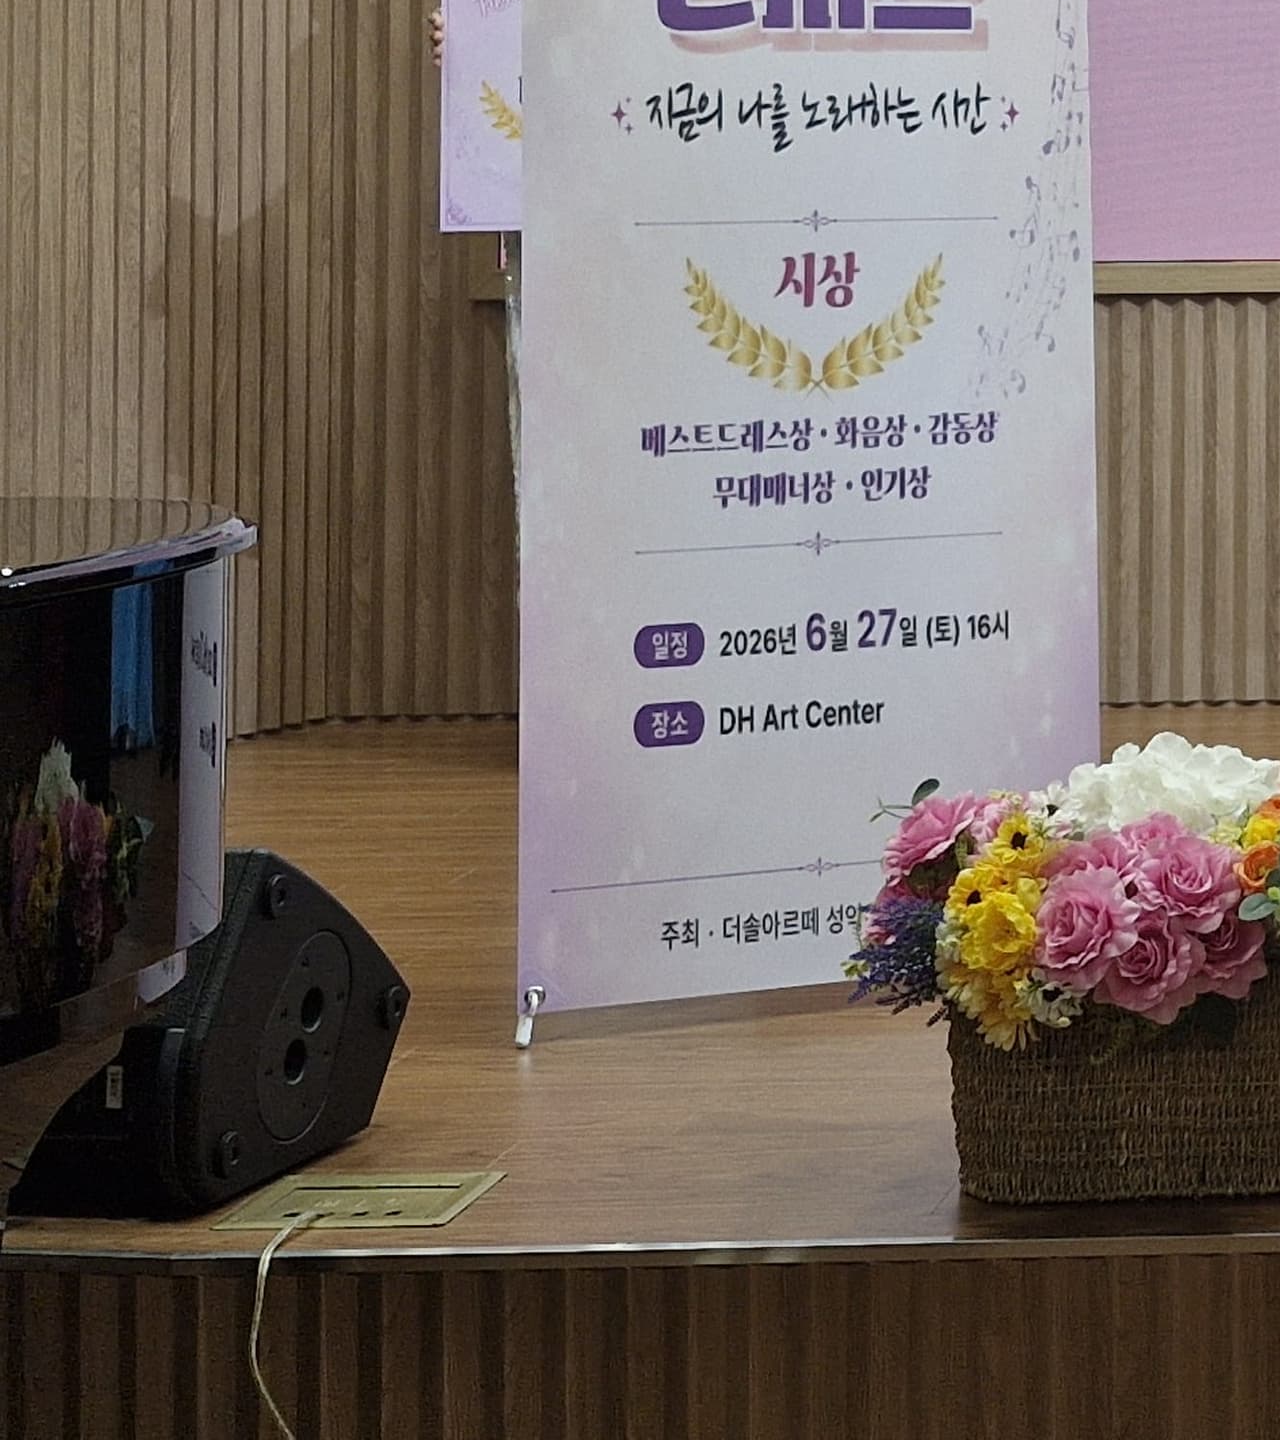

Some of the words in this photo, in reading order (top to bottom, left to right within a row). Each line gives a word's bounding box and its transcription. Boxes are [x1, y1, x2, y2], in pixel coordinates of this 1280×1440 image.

[646, 81, 724, 144] 지금의
[738, 82, 794, 153] 나를
[801, 80, 923, 135] 노래하는
[931, 80, 992, 136] 시간
[774, 251, 861, 309] 시상
[834, 414, 908, 450] 화음상
[928, 410, 1001, 446] 감동상
[712, 470, 837, 510] 무대매너상
[861, 465, 934, 502] 인기상
[650, 630, 689, 661] 일정
[719, 623, 797, 658] 2026년
[805, 612, 849, 653] 6월
[857, 607, 918, 649] 27일
[925, 615, 961, 649] (토)
[966, 609, 1010, 642] 16시
[650, 709, 689, 740] 장소
[719, 705, 755, 736] DH
[762, 702, 799, 733] Art
[804, 698, 885, 730] Center
[660, 917, 700, 952] 주최
[722, 906, 820, 946] 더솔아르떼
